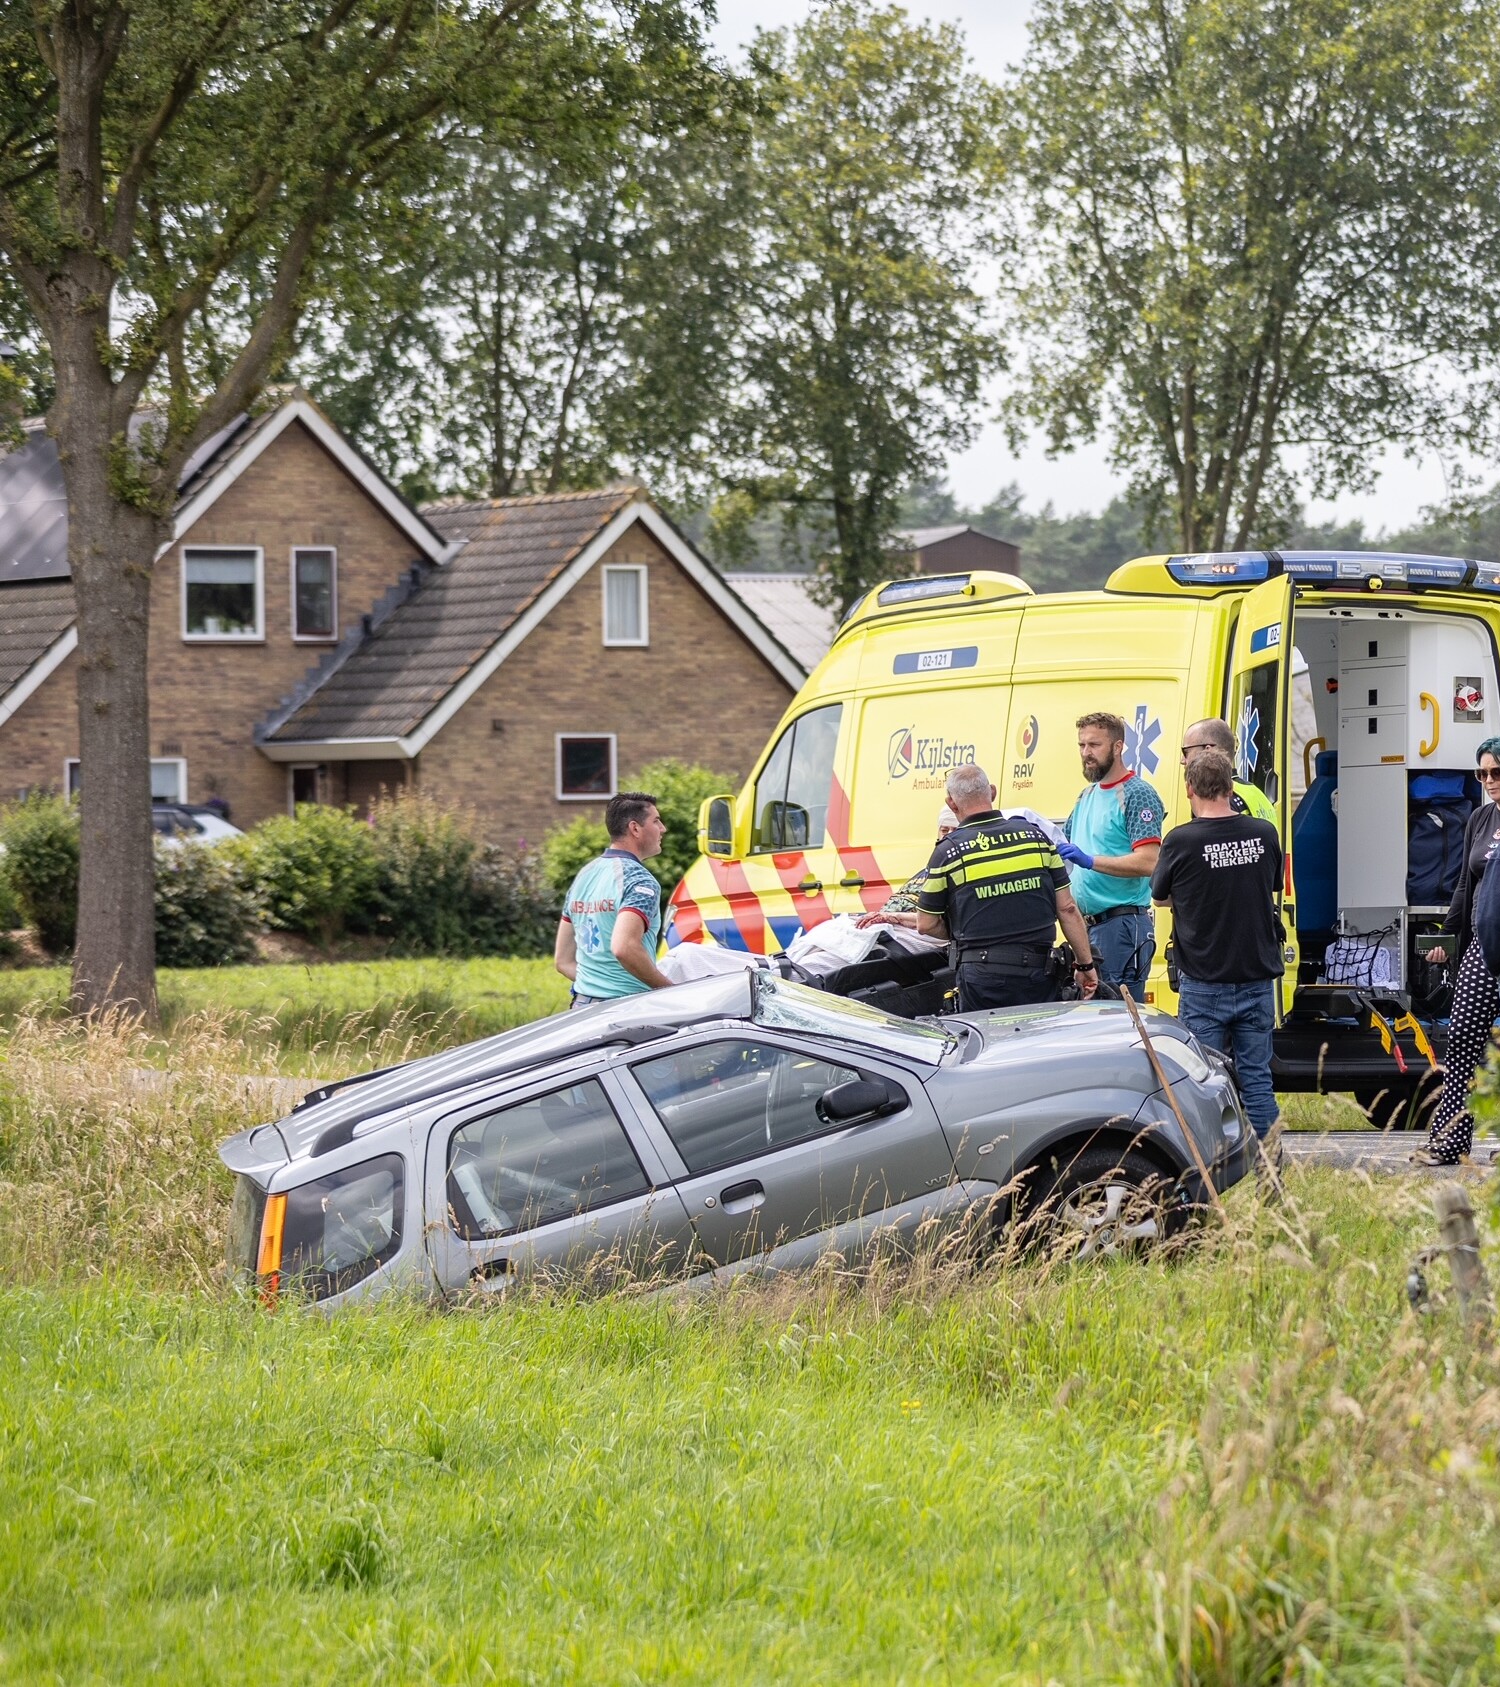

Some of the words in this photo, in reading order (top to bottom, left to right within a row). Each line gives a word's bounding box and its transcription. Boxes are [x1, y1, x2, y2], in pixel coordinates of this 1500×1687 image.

[922, 653, 948, 668] 02-121
[914, 737, 976, 776] Kijlstra
[1013, 763, 1035, 779] RAV
[1202, 845, 1265, 862] TREKKERS
[1204, 840, 1239, 854] GOA'J
[1240, 837, 1262, 849] MIT
[1210, 854, 1260, 869] KIEKEN?
[975, 876, 1041, 899] WIJKAGENT
